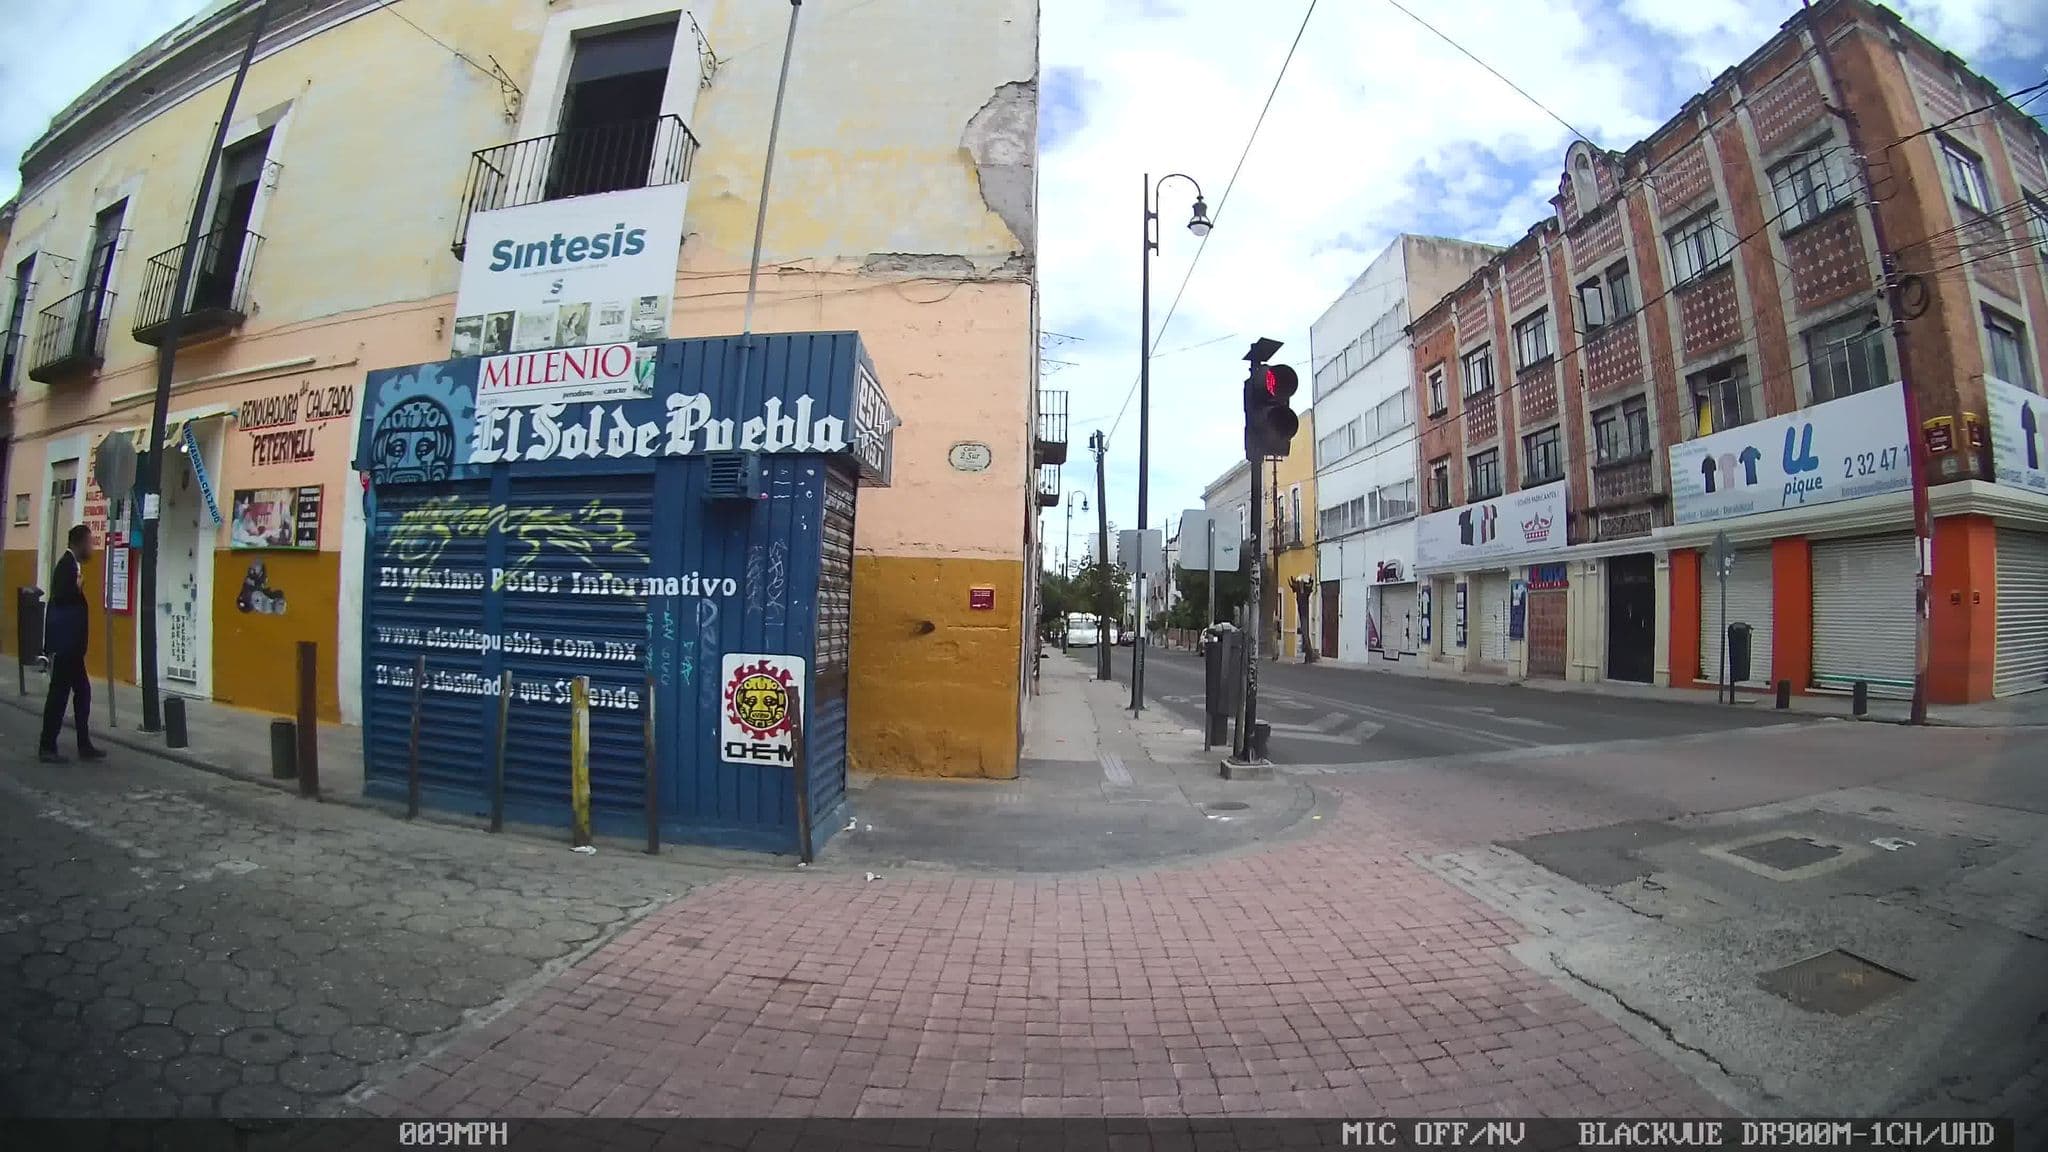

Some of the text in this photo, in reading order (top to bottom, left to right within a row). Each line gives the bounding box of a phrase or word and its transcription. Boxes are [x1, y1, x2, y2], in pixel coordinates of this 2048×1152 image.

[481, 344, 633, 390] MILENIO
[240, 391, 299, 430] RENOVADORA
[305, 384, 354, 420] CALZADO
[468, 392, 848, 464] El Sol de Puebla
[967, 452, 980, 460] Sur
[1843, 456, 1854, 479] 2
[1857, 452, 1876, 476] 32
[1880, 446, 1898, 471] 47
[1782, 475, 1823, 507] pique
[379, 566, 399, 588] El
[491, 567, 564, 594] Poder
[571, 571, 737, 597] Informativo
[376, 626, 637, 662] www.elsoldepuebla.com.mx
[391, 666, 430, 690] únio
[520, 682, 551, 704] que
[586, 685, 640, 709] ende
[725, 742, 794, 762] OEM
